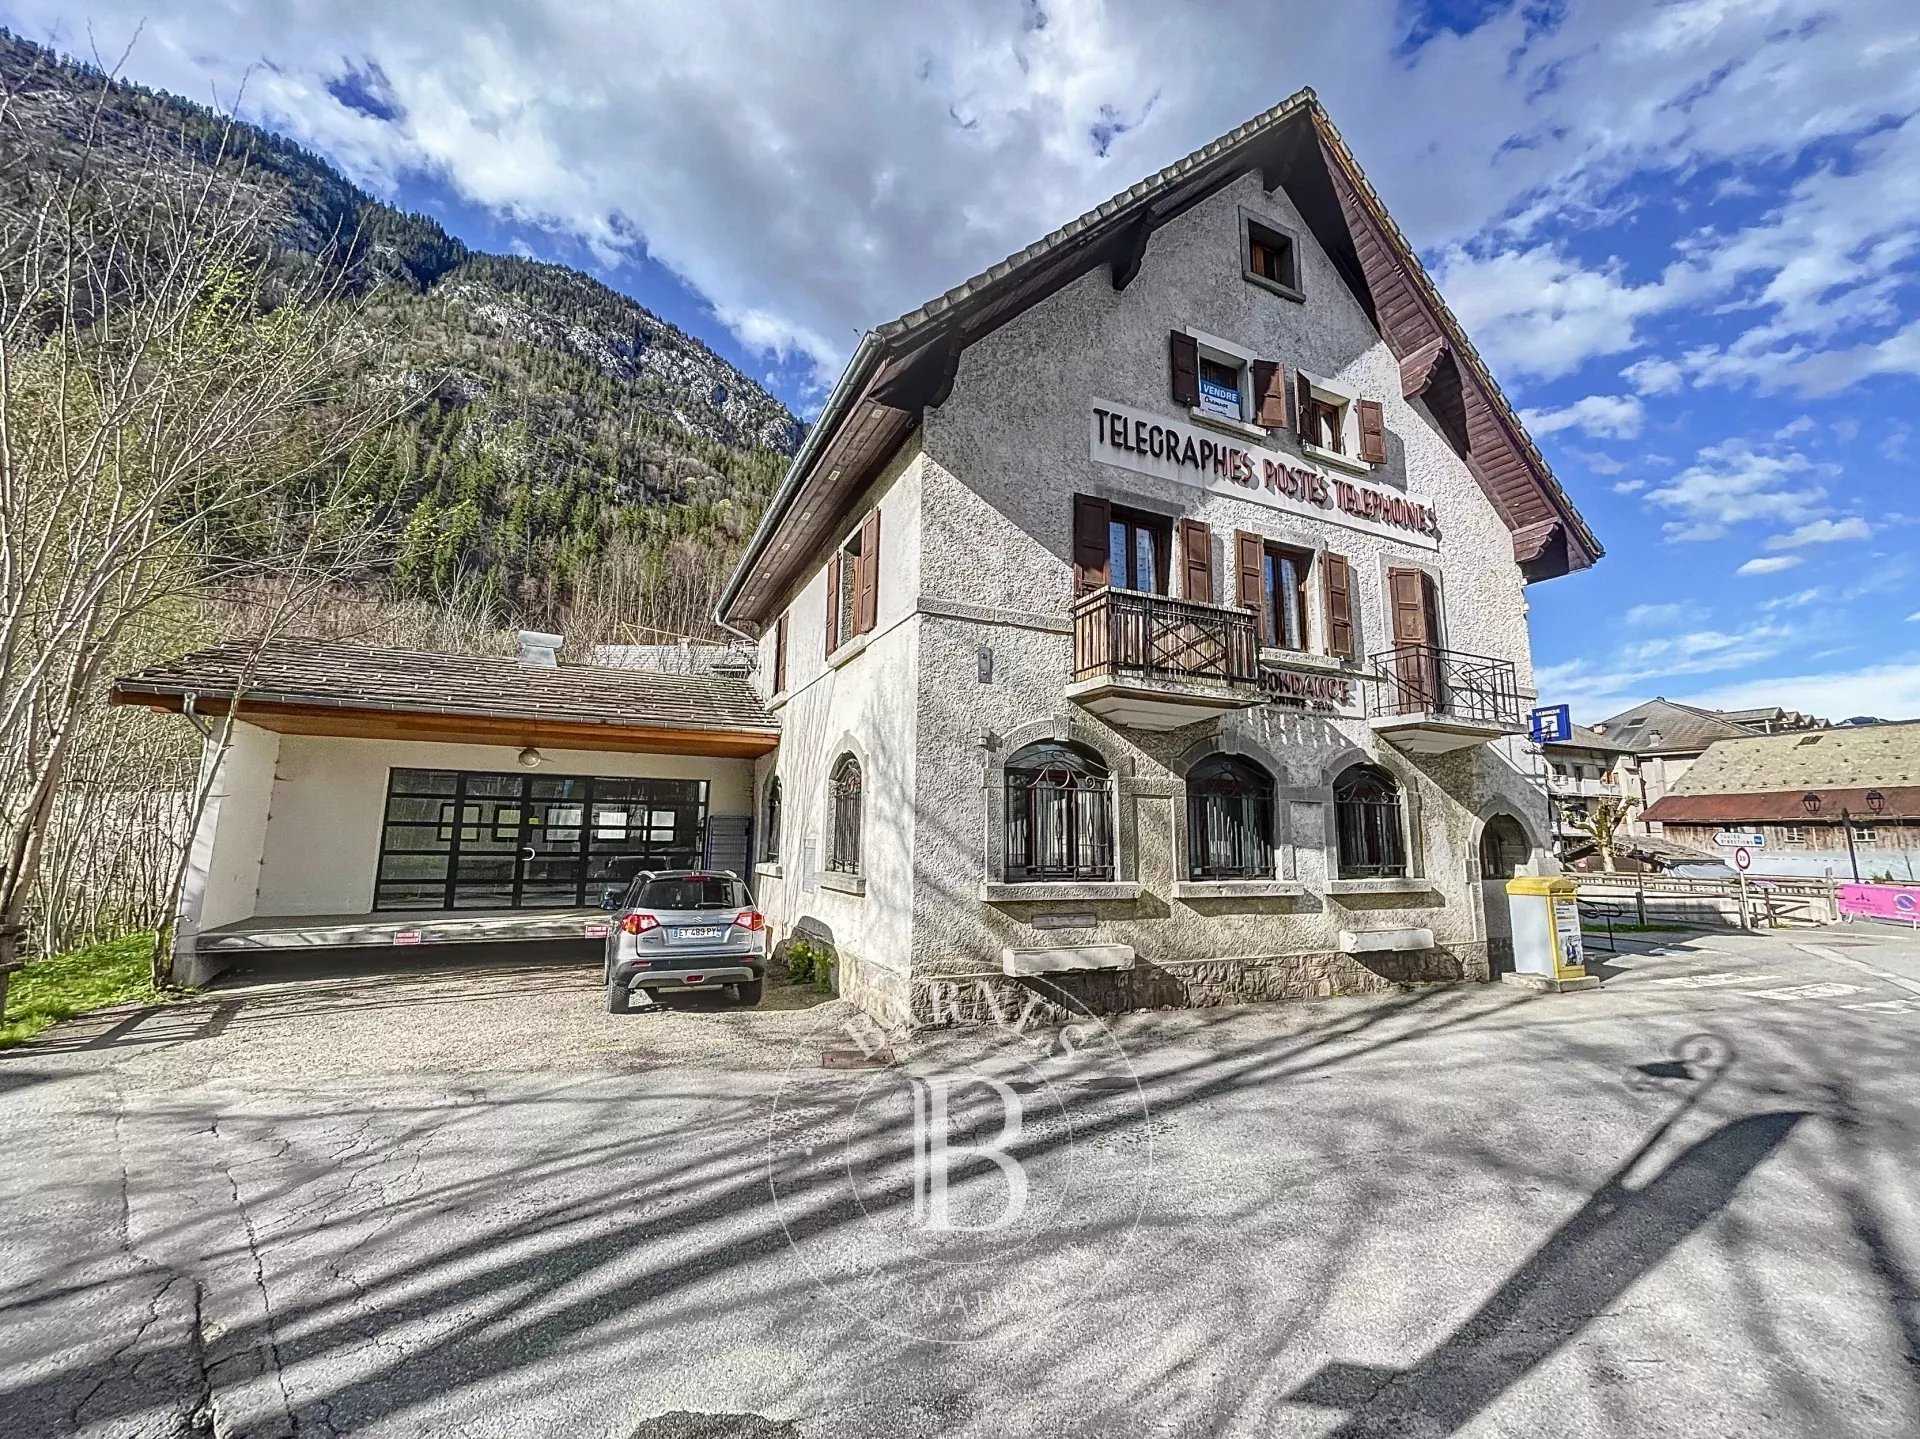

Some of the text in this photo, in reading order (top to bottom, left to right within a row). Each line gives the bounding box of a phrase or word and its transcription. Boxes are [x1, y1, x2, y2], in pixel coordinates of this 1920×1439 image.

[1203, 383, 1238, 402] VENDRE
[1093, 407, 1437, 533] TELEGRAPHES POSTES TELEPHONES
